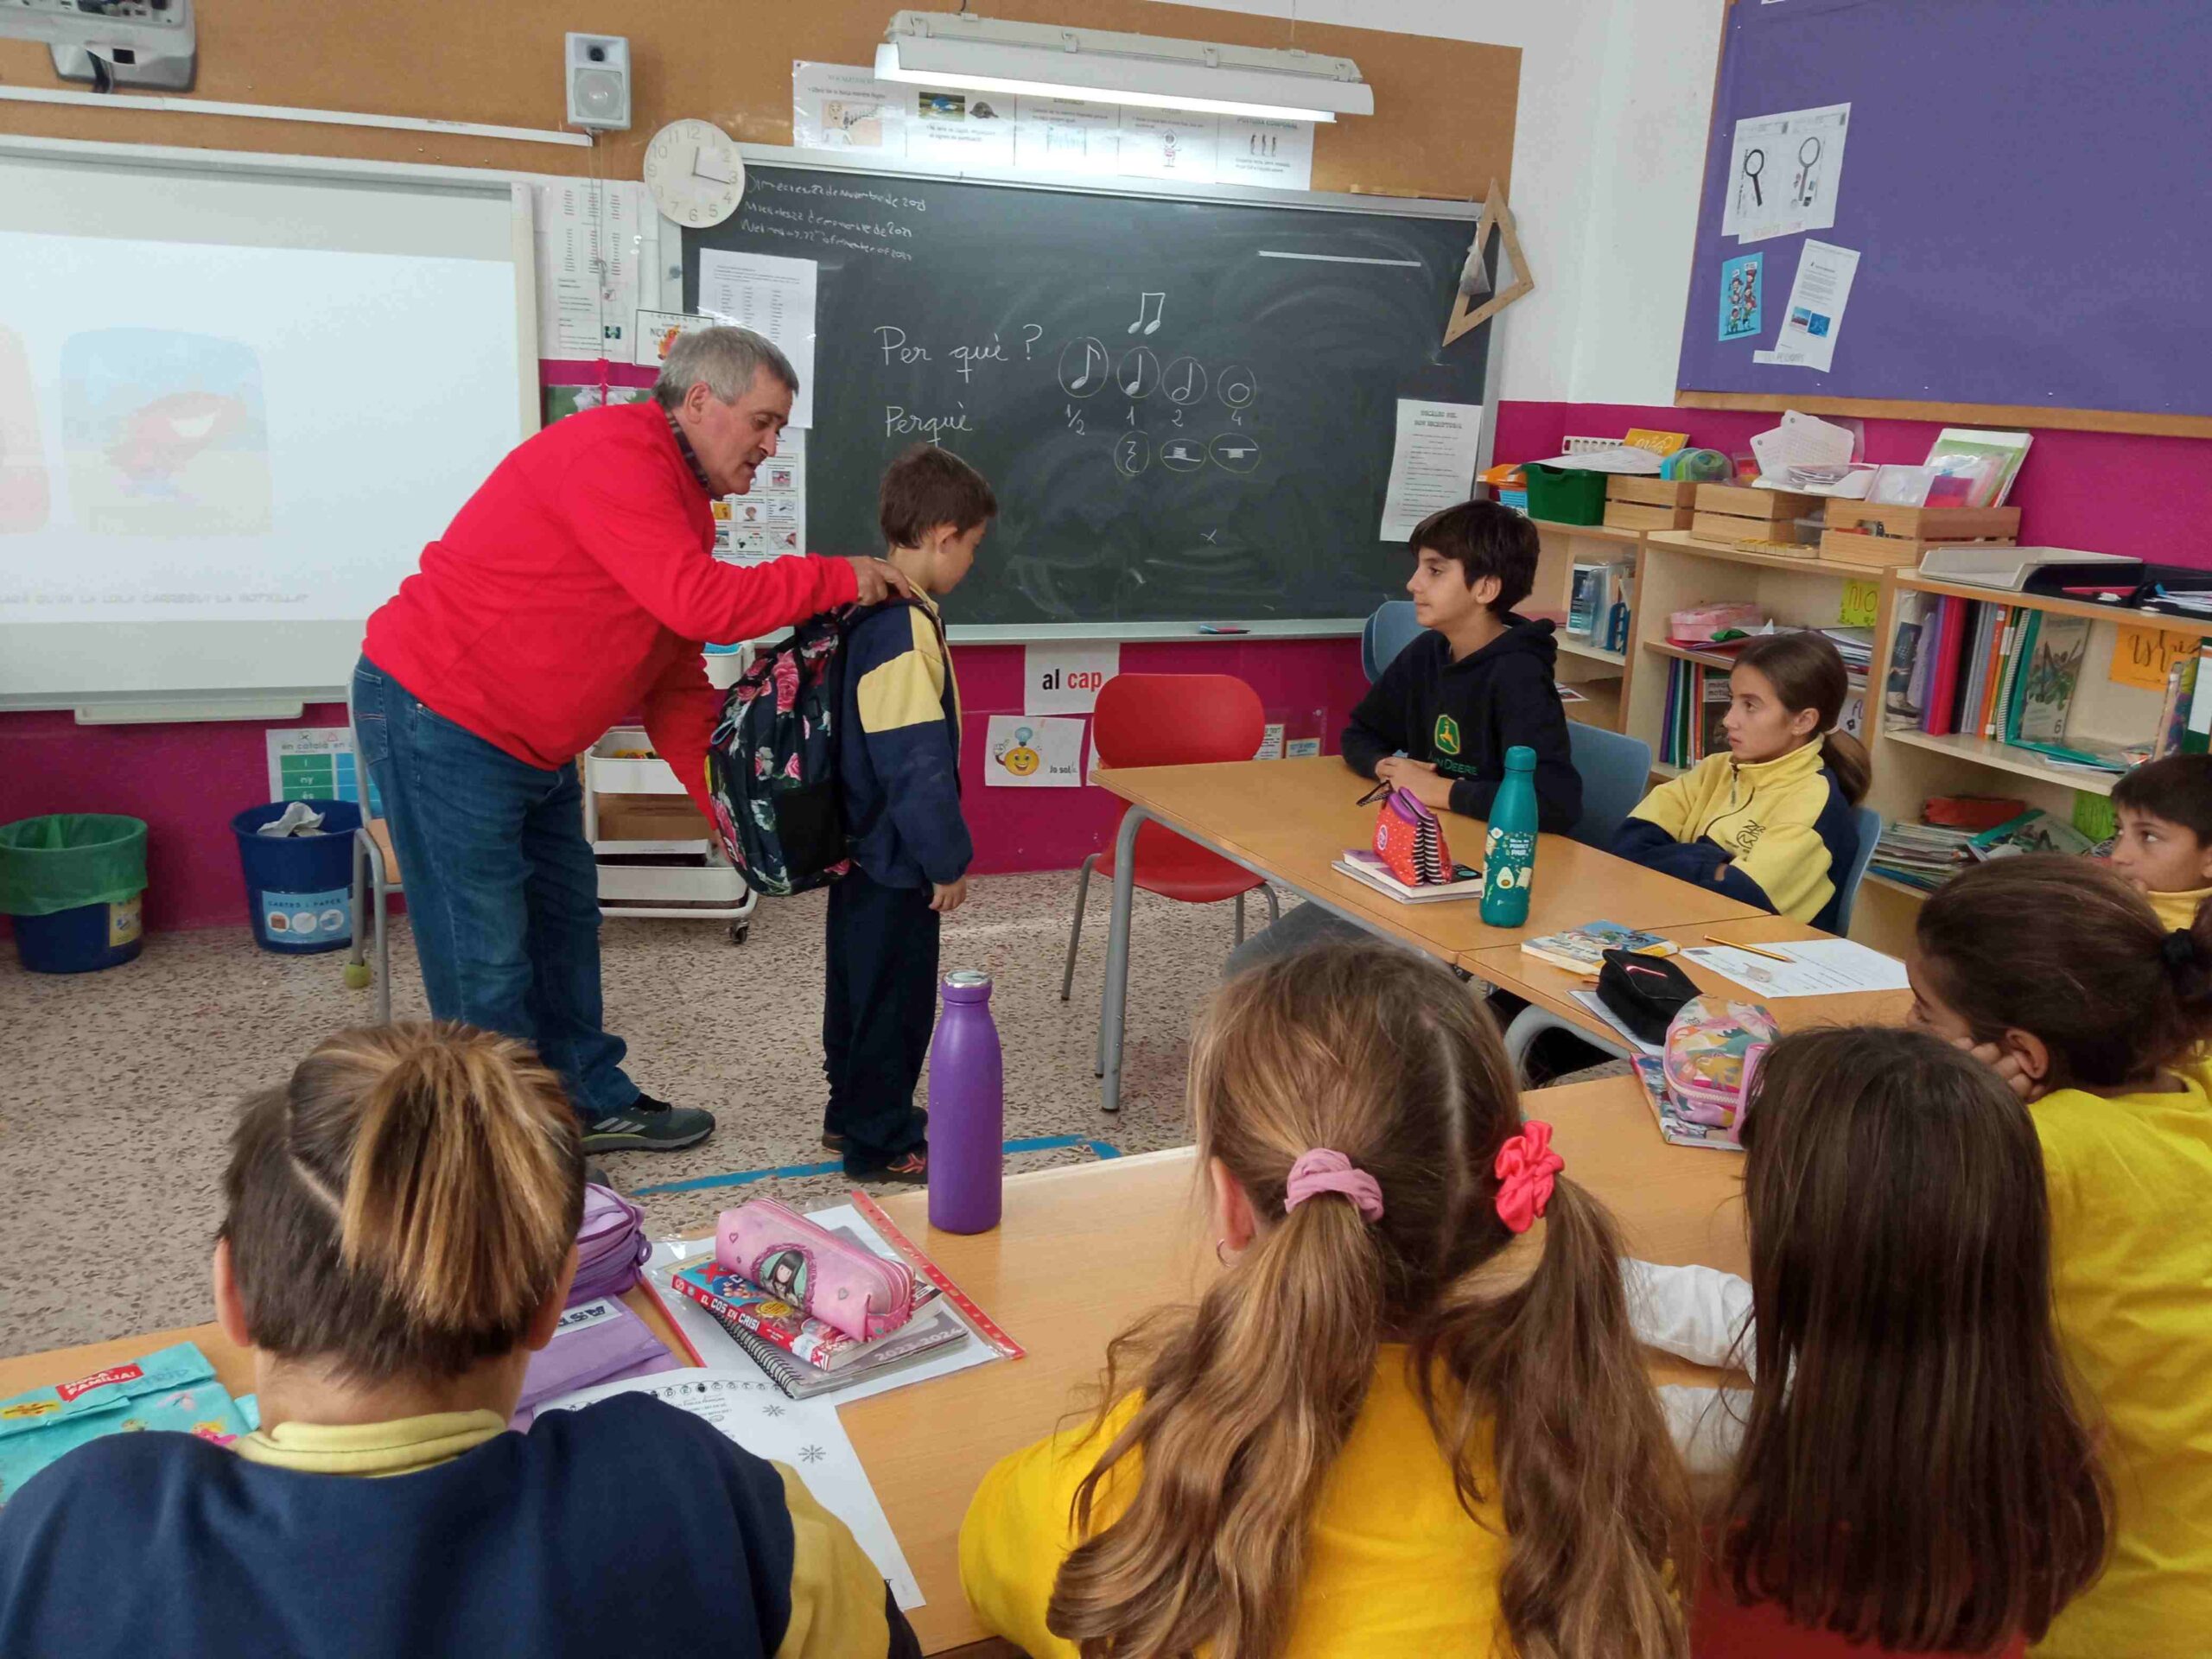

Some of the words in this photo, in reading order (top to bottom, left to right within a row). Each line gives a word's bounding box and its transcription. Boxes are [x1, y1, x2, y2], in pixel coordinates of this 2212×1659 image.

[668, 129, 679, 144] 11
[687, 125, 701, 140] 12
[711, 132, 716, 147] 1
[652, 142, 668, 160] 10
[721, 147, 732, 163] 2
[647, 163, 658, 178] 9
[728, 170, 739, 185] 3
[722, 190, 733, 205] 4
[670, 200, 680, 214] 7
[709, 203, 719, 219] 5
[689, 208, 699, 222] 6
[873, 325, 933, 366] Per
[1022, 323, 1044, 362] ?
[1126, 405, 1135, 426] 1
[1172, 409, 1184, 428] 2
[1230, 408, 1243, 427] 4
[884, 400, 974, 448] Perquè
[79, 593, 96, 604] LA
[215, 593, 232, 604] LA
[1042, 668, 1060, 690] al
[1067, 671, 1103, 692] cap
[2053, 719, 2063, 734] 6
[1444, 758, 1479, 776] DEERE
[300, 776, 314, 785] ny
[700, 1294, 709, 1306] EL
[710, 1298, 728, 1314] COS
[728, 1308, 739, 1320] EN
[739, 1313, 760, 1332] CRISI
